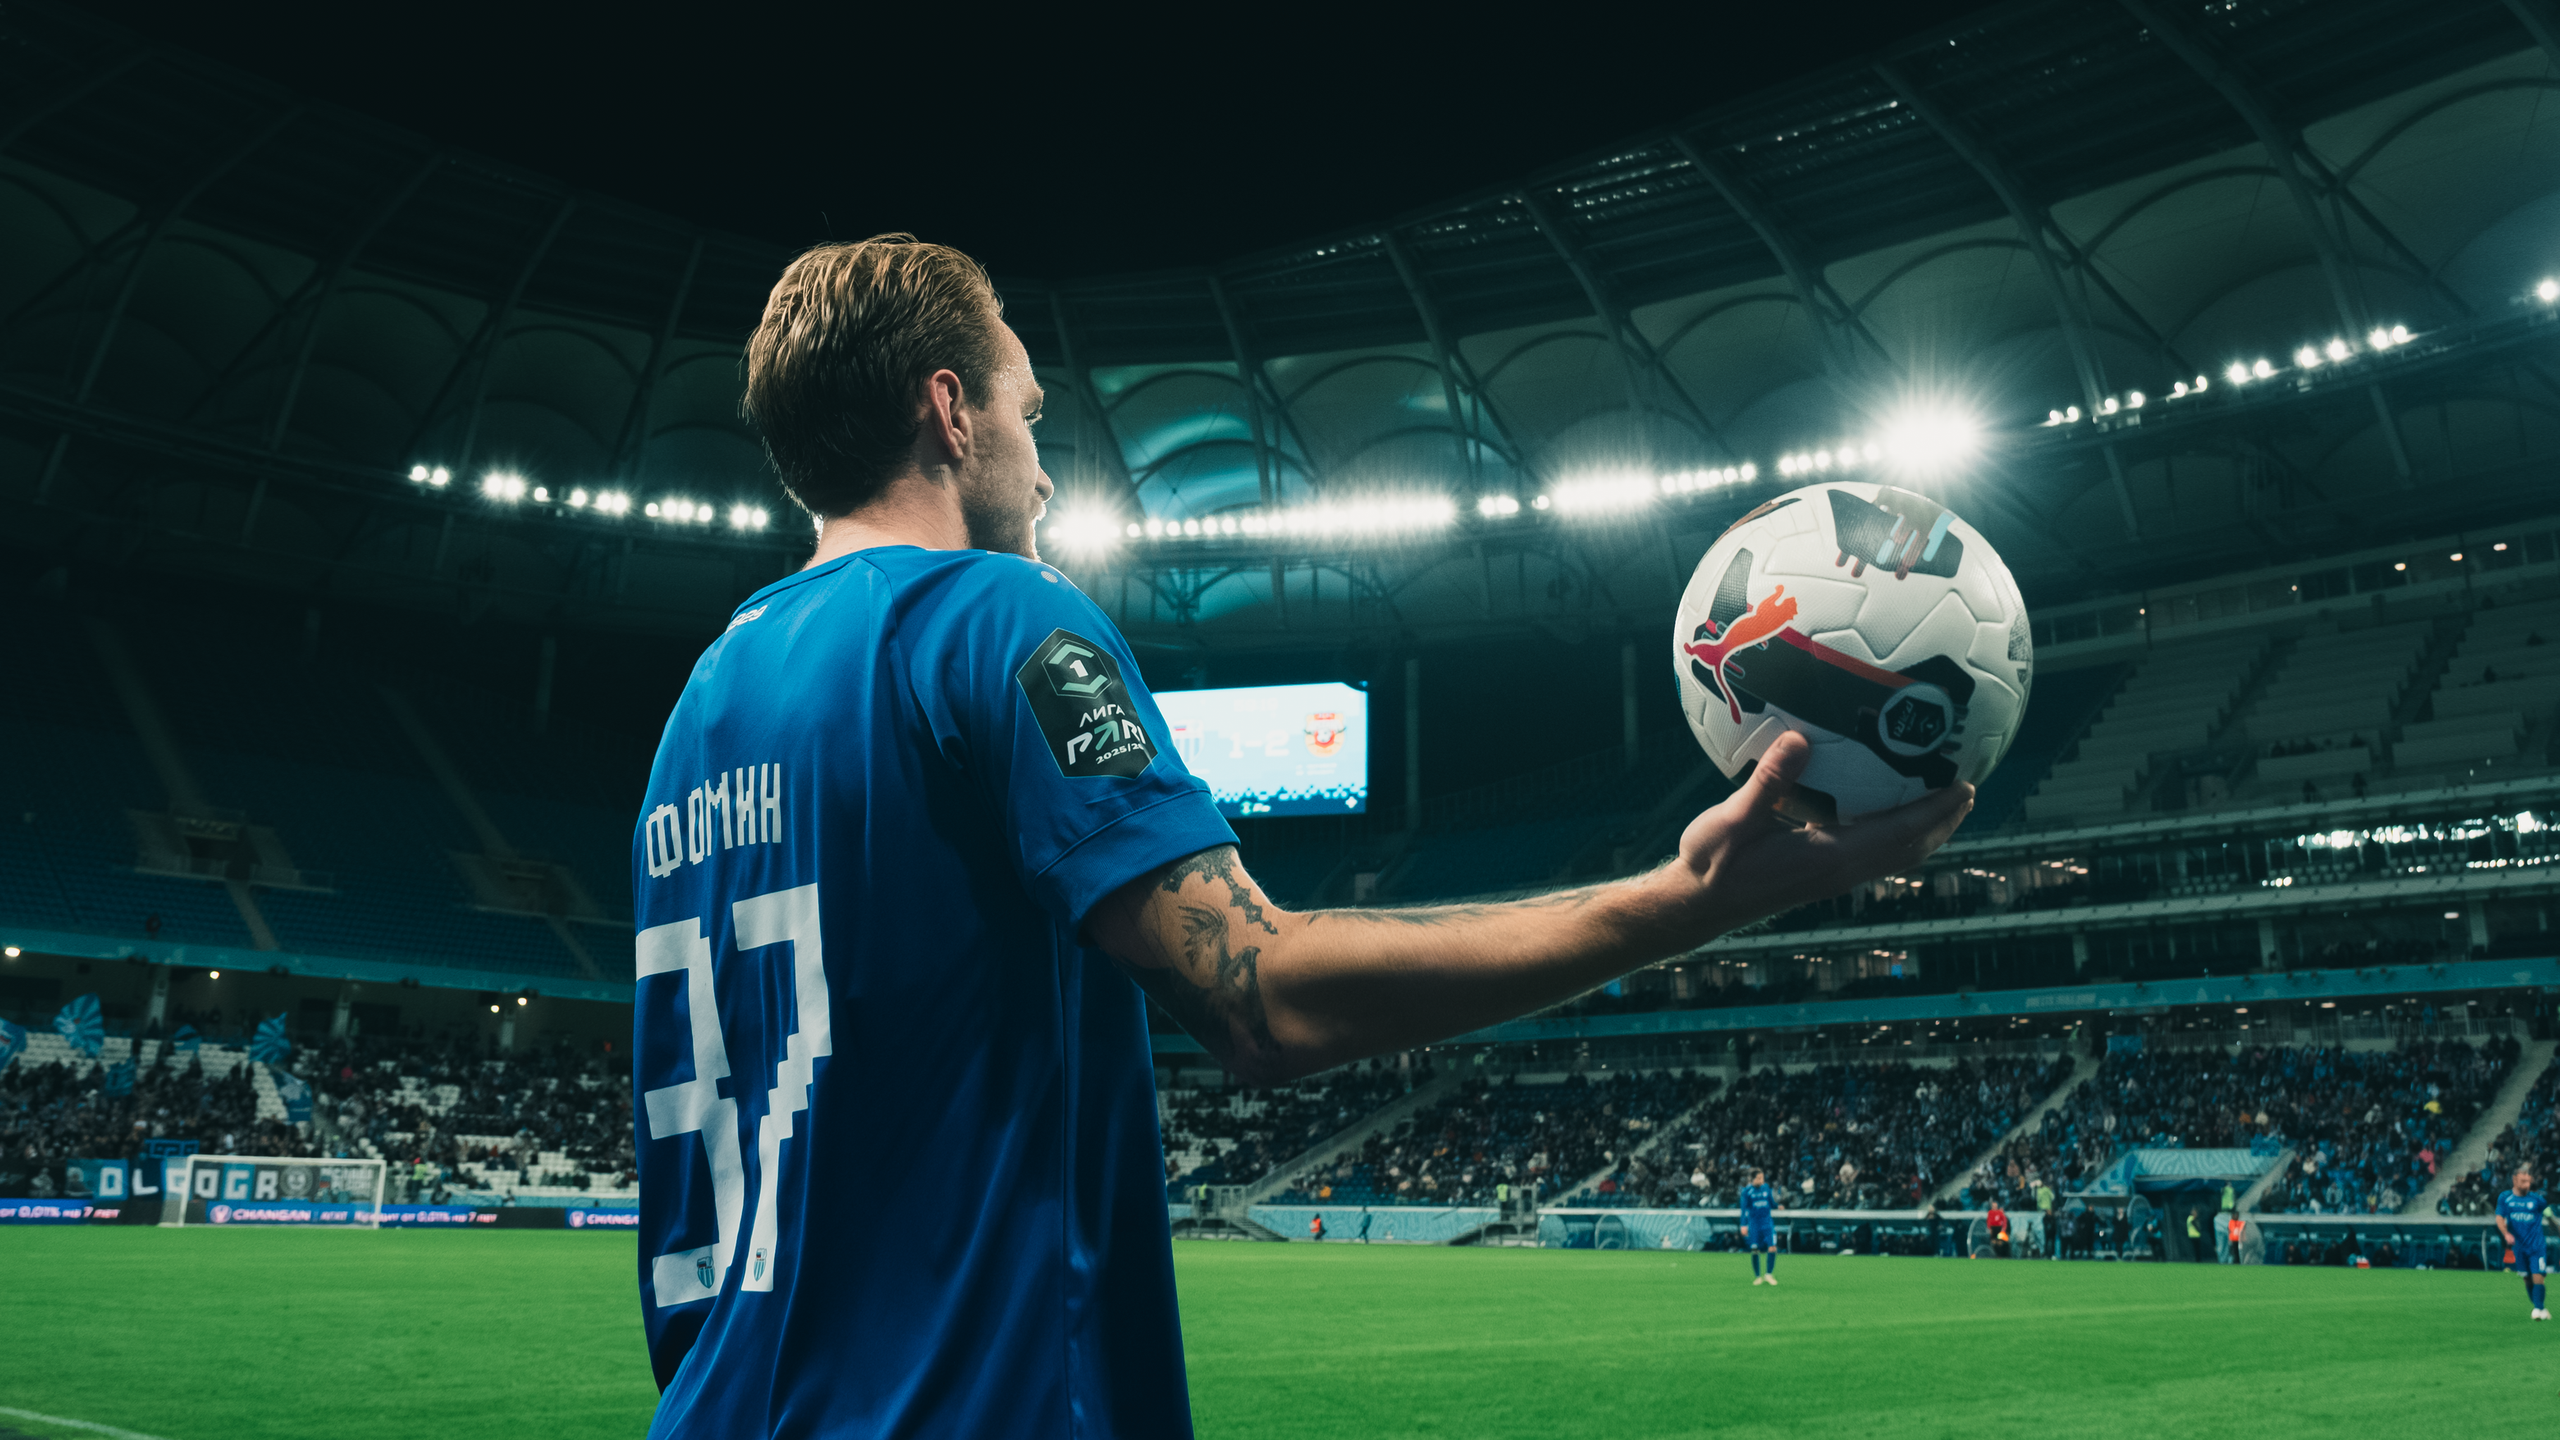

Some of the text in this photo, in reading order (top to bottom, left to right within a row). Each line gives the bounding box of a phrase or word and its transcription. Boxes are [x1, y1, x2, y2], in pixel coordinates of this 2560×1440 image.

[1069, 659, 1089, 678] 1
[1079, 703, 1125, 728] ЛИГА
[1066, 718, 1146, 766] PARI
[645, 762, 782, 879] ФОМИН
[635, 882, 833, 1309] 37
[232, 1208, 312, 1221] CHANGAN
[586, 1213, 639, 1225] CHANG
